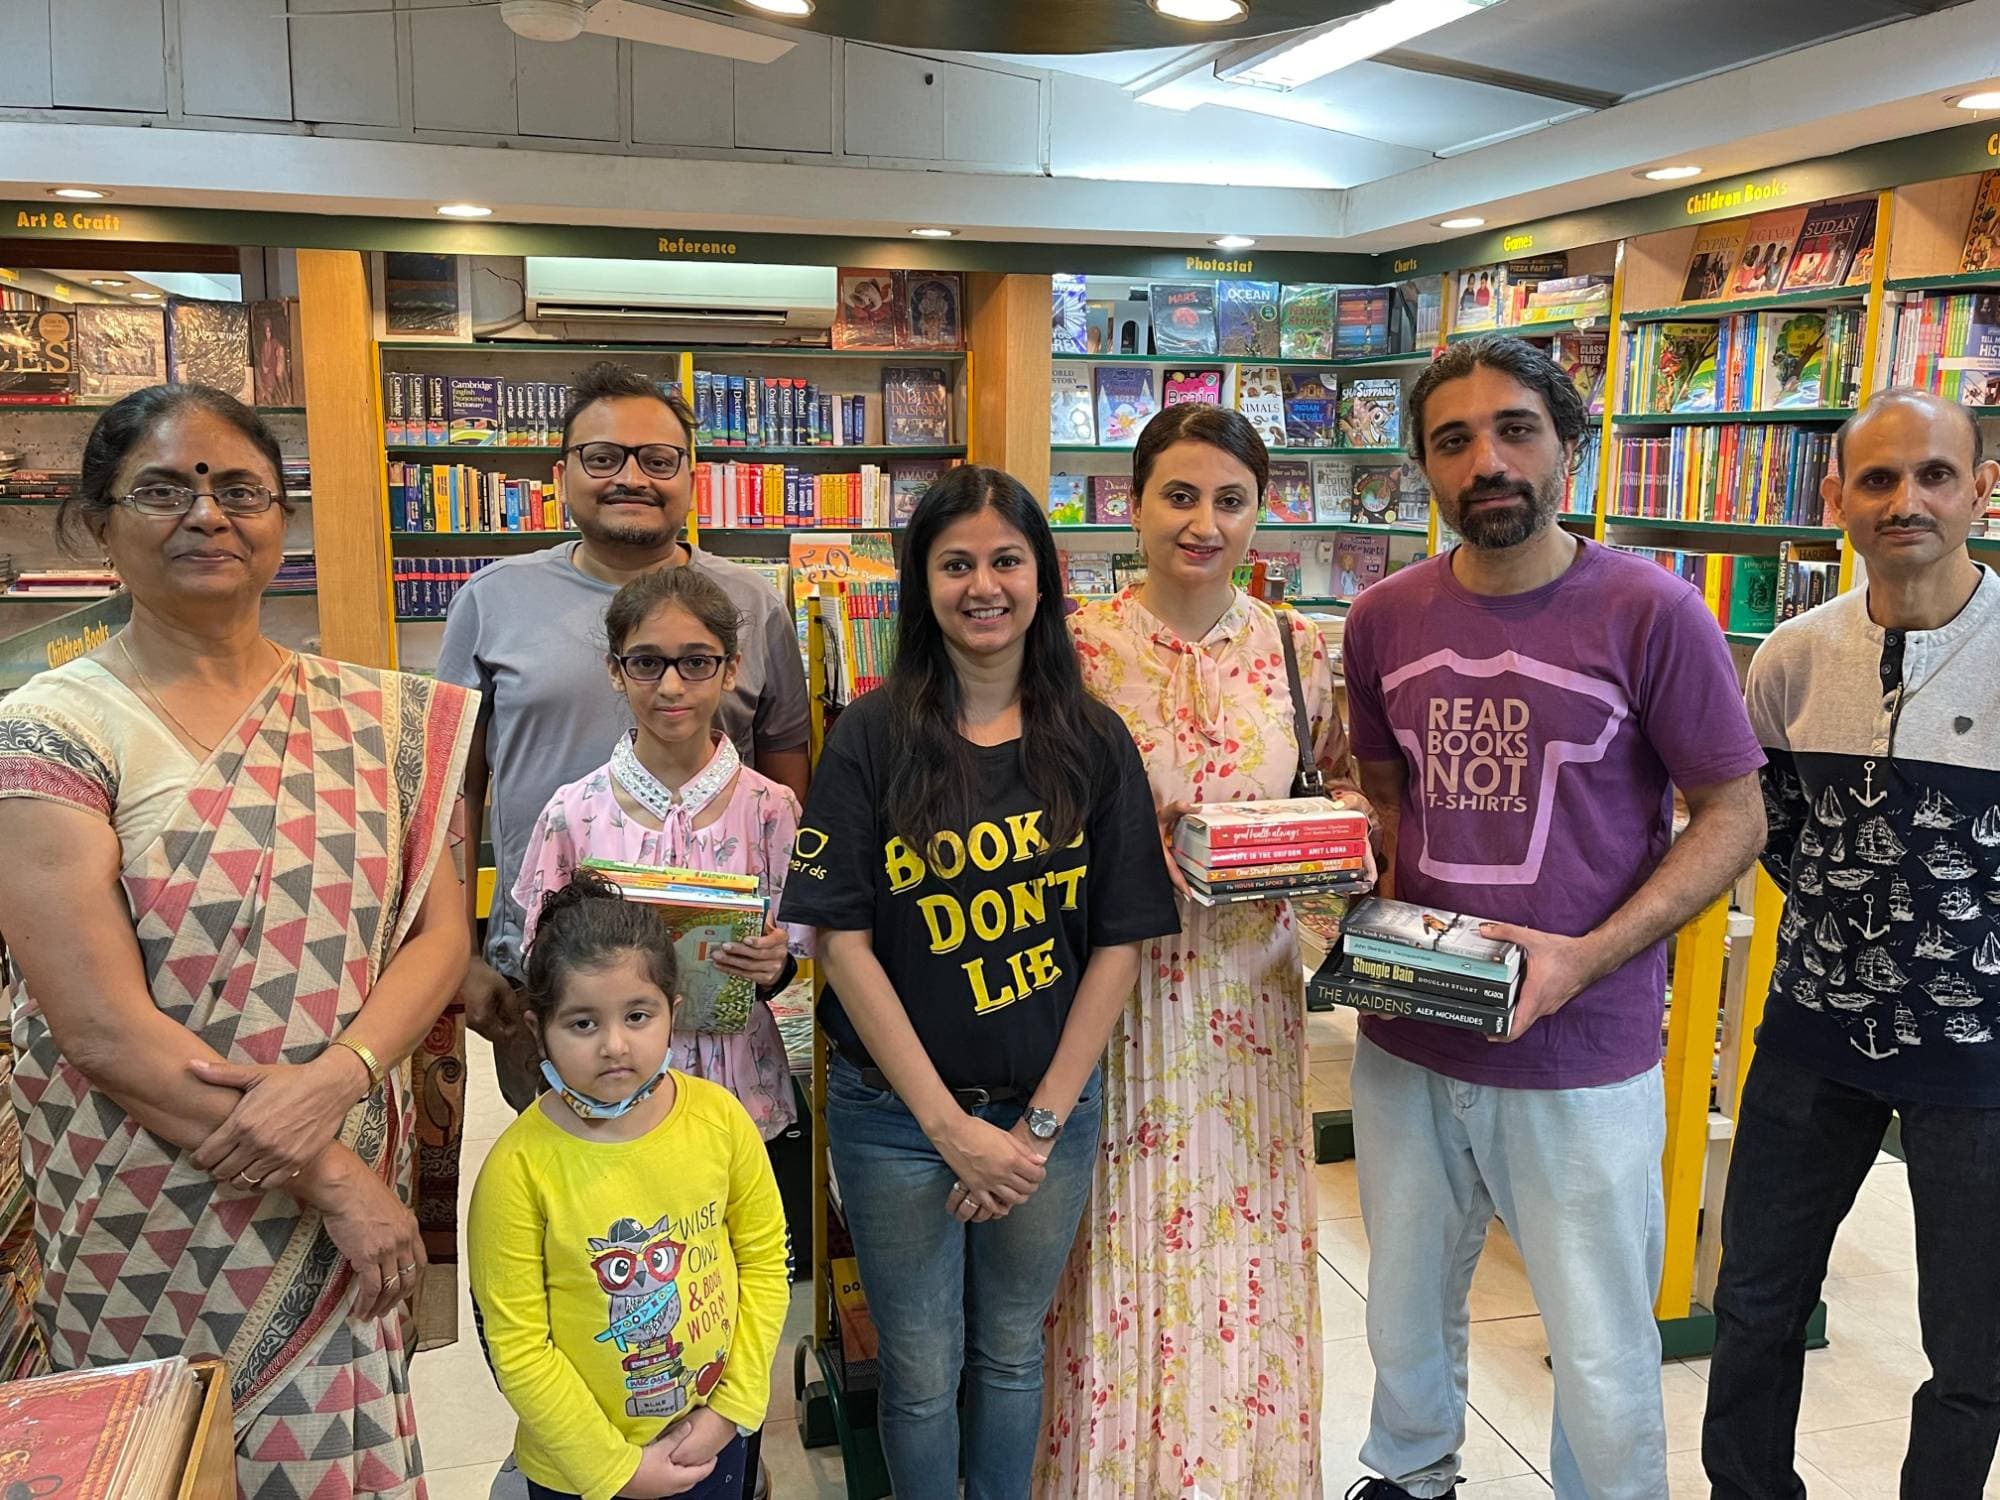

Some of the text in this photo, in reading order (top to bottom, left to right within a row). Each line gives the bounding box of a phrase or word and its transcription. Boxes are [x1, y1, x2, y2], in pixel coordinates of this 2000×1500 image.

[1687, 179, 1789, 215] Children Books
[17, 211, 121, 231] Art & Craft
[1803, 215, 1860, 237] SUDAN
[658, 237, 737, 255] Reference
[1503, 234, 1533, 252] Games
[1185, 256, 1254, 274] Photostat
[1394, 258, 1418, 275] Charts
[1228, 287, 1271, 301] OCEAN
[451, 380, 493, 391] Cambridge
[452, 389, 476, 398] English
[1168, 388, 1215, 404] Brain
[452, 402, 484, 410] Dictionary
[768, 388, 776, 415] Oxford
[783, 388, 791, 415] Oxford
[1239, 402, 1280, 413] NIMALS
[896, 471, 938, 481] JAMAICA
[1779, 562, 1787, 587] HARRY
[1777, 588, 1786, 617] POTTER
[47, 620, 110, 670] Children Books
[1428, 697, 1530, 732] READ
[1427, 730, 1529, 758] BOOKS
[1426, 756, 1528, 797] NOT
[1426, 793, 1528, 813] T-SHIRTS
[1259, 850, 1271, 859] THE
[1308, 847, 1324, 855] AMIT
[1265, 879, 1284, 887] SPOKE
[916, 865, 1087, 955] DON'T
[961, 937, 1063, 1016] LIE
[1352, 956, 1391, 979] Shuggie
[1392, 964, 1415, 984] Bain
[1418, 977, 1450, 989] DOUGLAS
[1451, 983, 1478, 994] STUART
[1317, 985, 1343, 1001] THE
[1345, 991, 1413, 1015] MAIDENS
[1415, 1006, 1435, 1017] ALEX
[1435, 1011, 1483, 1026] MICHAELIDES
[679, 1200, 718, 1241] WISE
[687, 1239, 719, 1273] OWL
[688, 1269, 723, 1313] & BOOK
[687, 1290, 729, 1345] WORM
